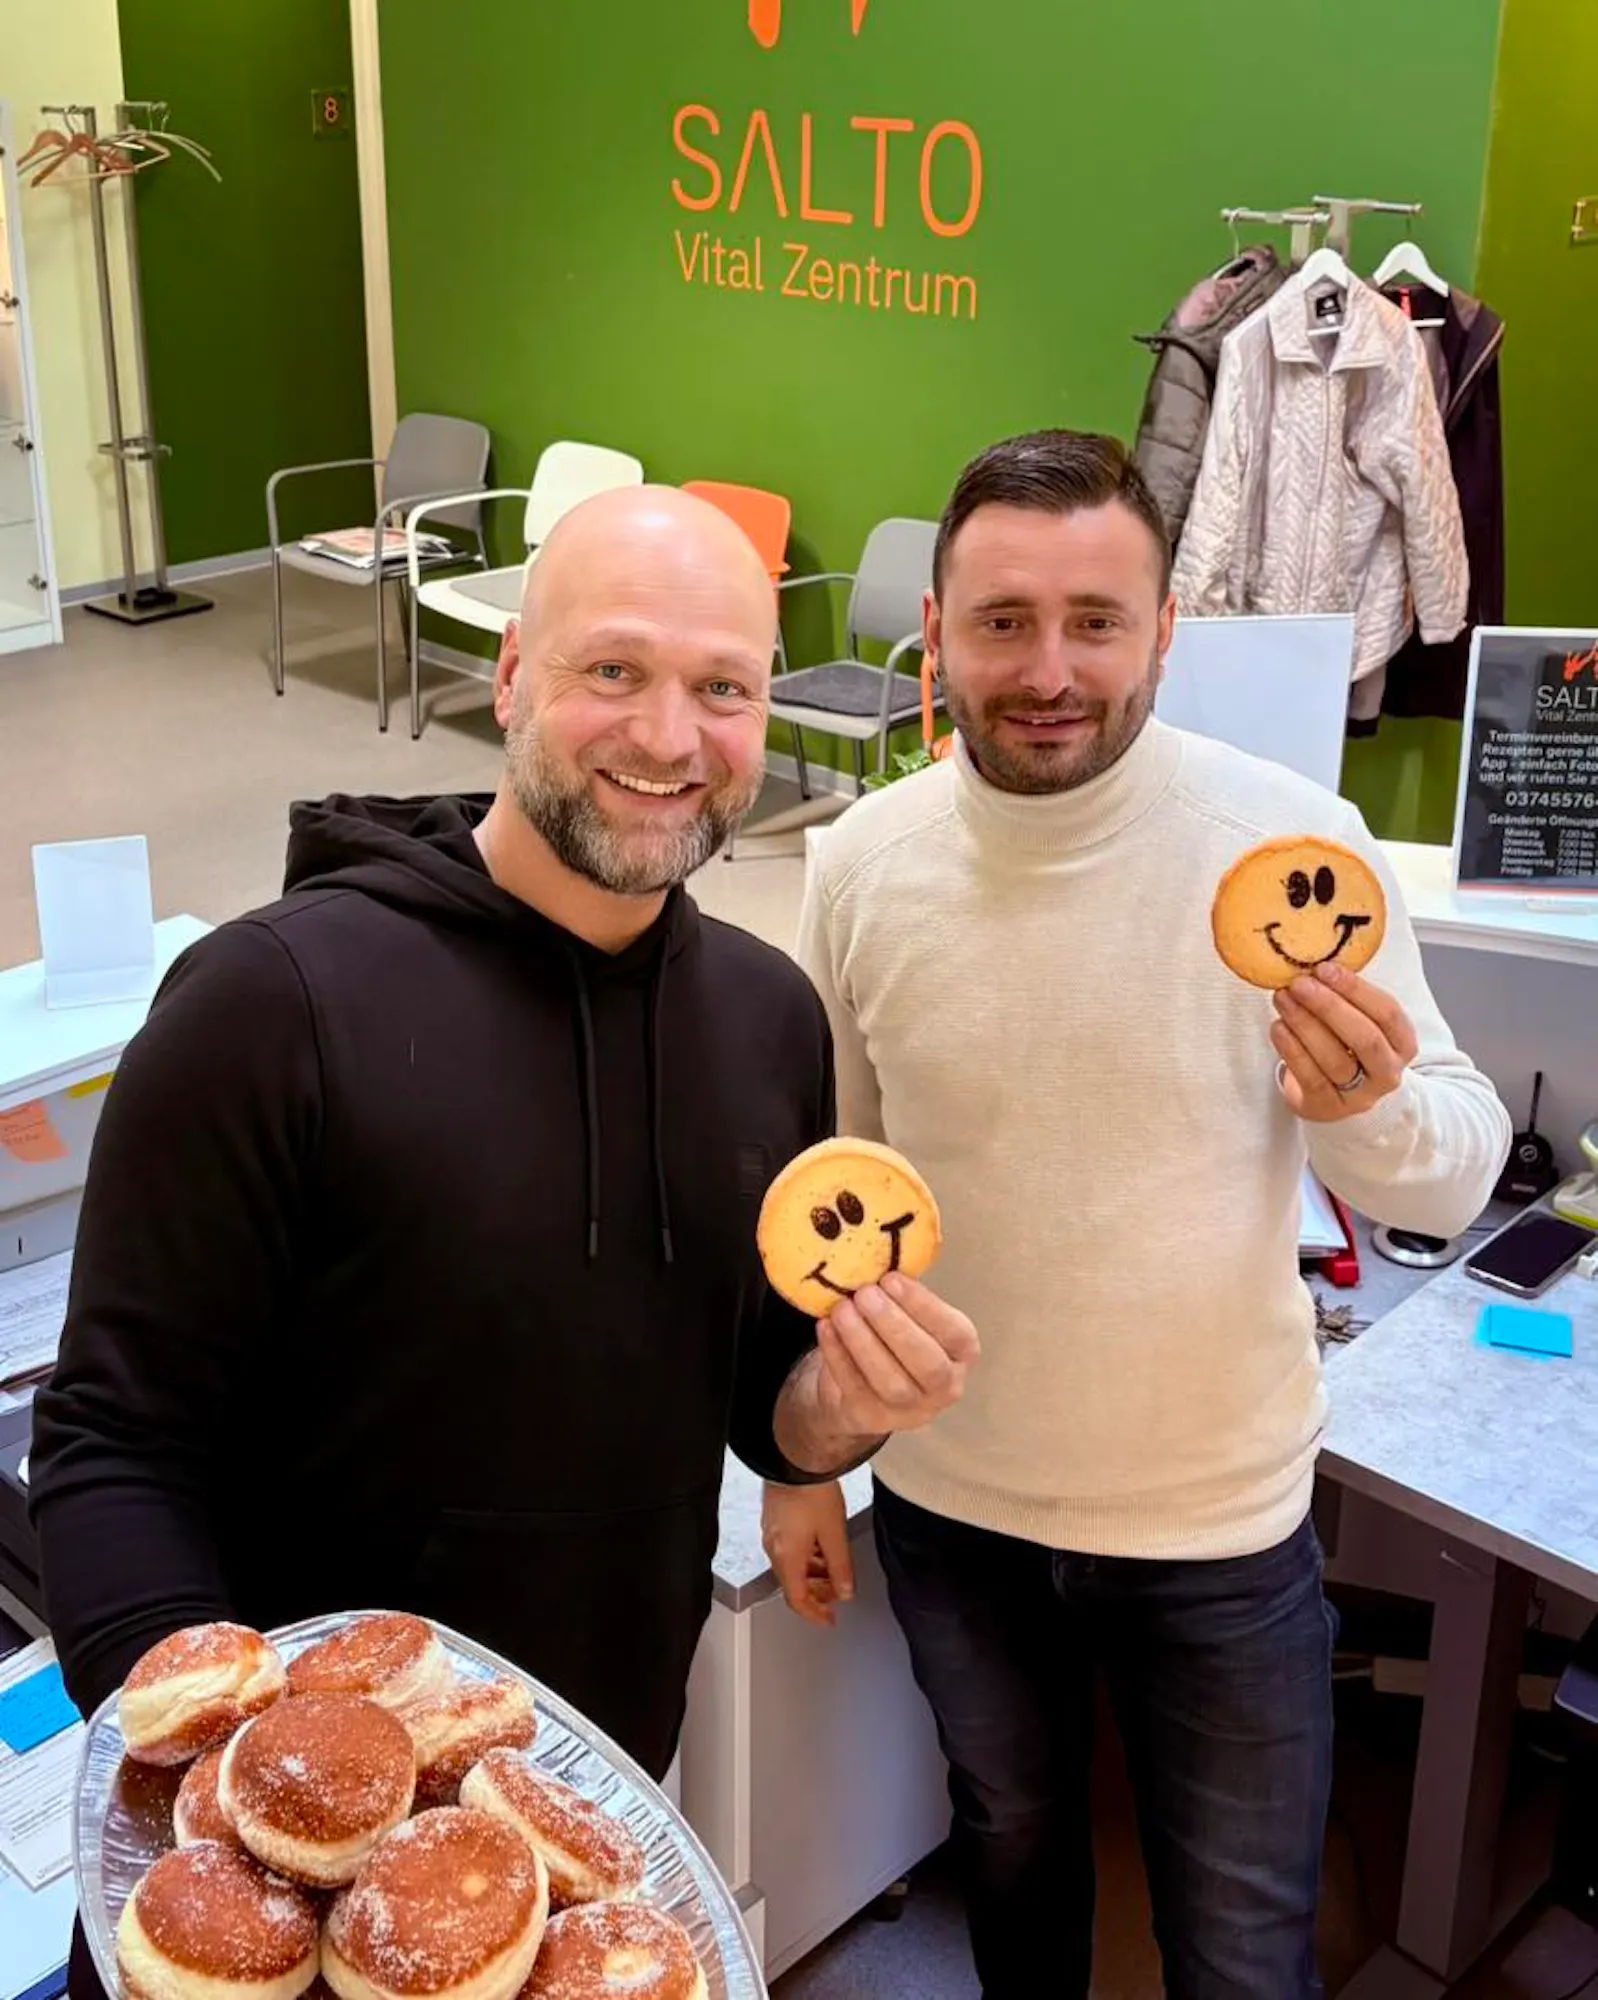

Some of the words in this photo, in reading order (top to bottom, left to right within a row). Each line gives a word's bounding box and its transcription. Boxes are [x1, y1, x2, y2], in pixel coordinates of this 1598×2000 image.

[325, 97, 339, 123] 8
[672, 104, 983, 238] SALTO
[674, 229, 764, 291] Vital
[781, 242, 978, 319] Zentrum
[1536, 709, 1564, 722] Vital
[1481, 743, 1543, 757] Rezepten
[1546, 747, 1584, 758] gerne
[1480, 757, 1507, 770] App
[1519, 758, 1567, 770] einfach
[1479, 771, 1504, 782] und
[1506, 772, 1526, 783] wir
[1530, 773, 1564, 784] rufen
[1567, 773, 1588, 784] Sie
